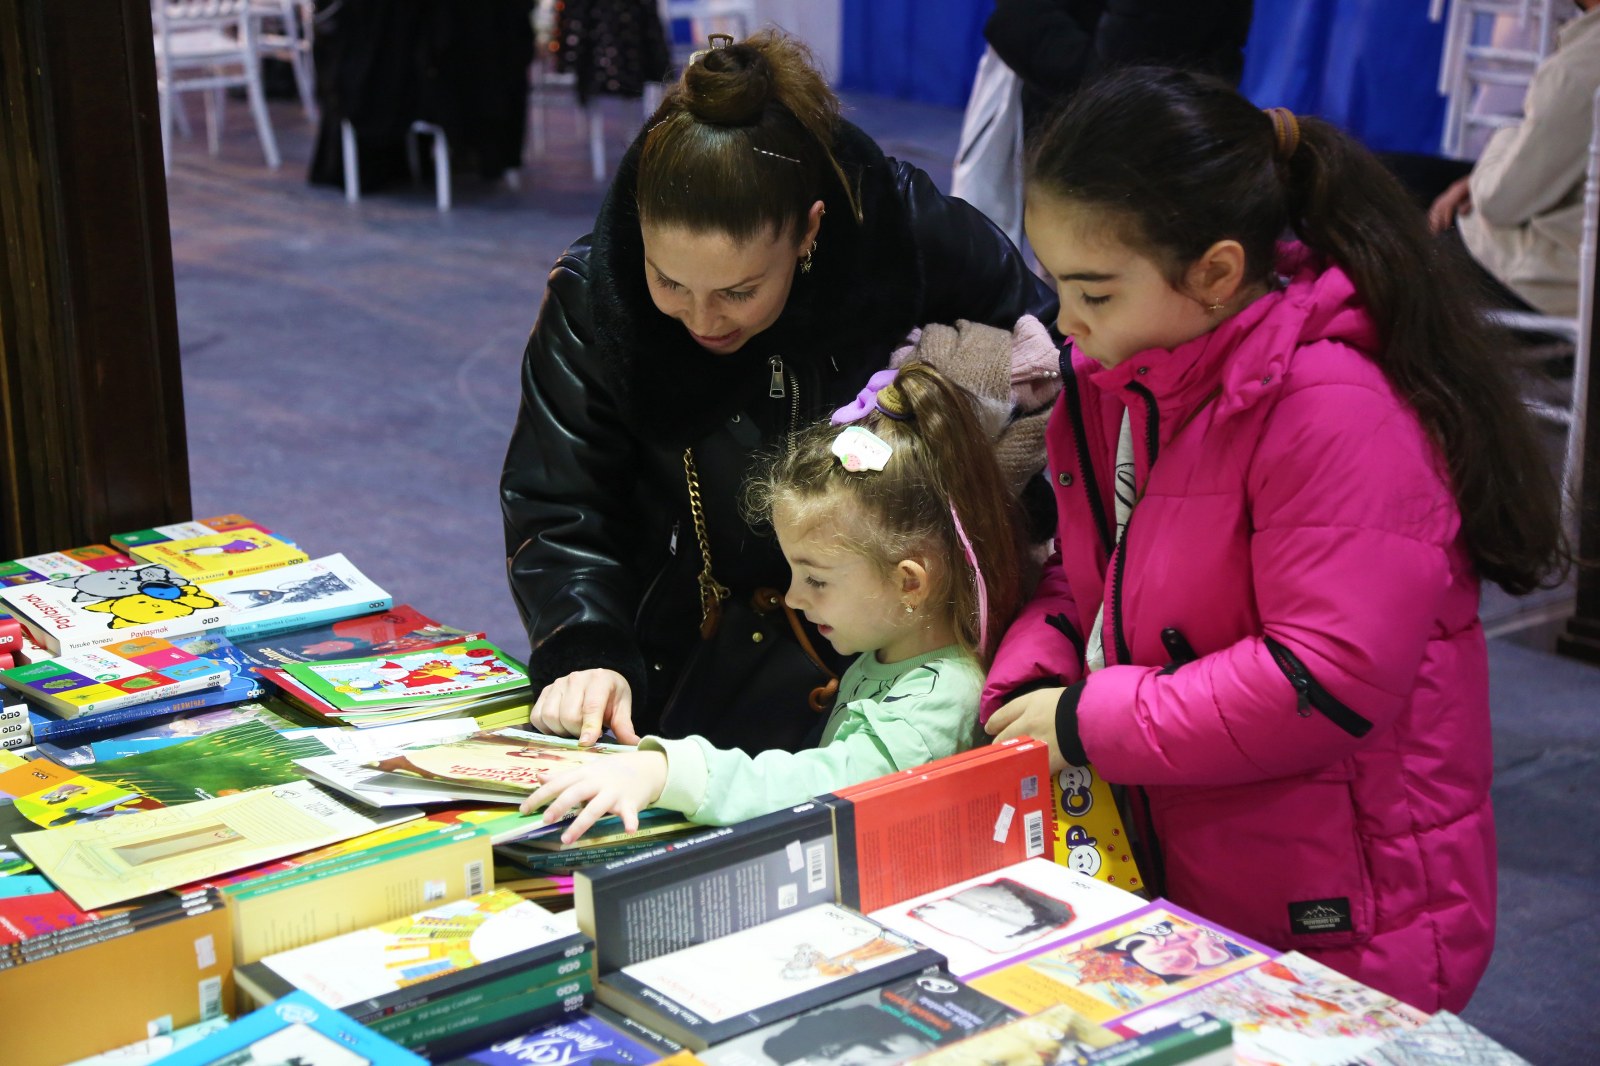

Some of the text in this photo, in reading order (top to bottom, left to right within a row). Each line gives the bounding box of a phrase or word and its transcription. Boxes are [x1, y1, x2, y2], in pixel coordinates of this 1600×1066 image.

[20, 593, 76, 630] Paylaşmak
[69, 625, 169, 650] Yusuke Yonezu Paylaşmak
